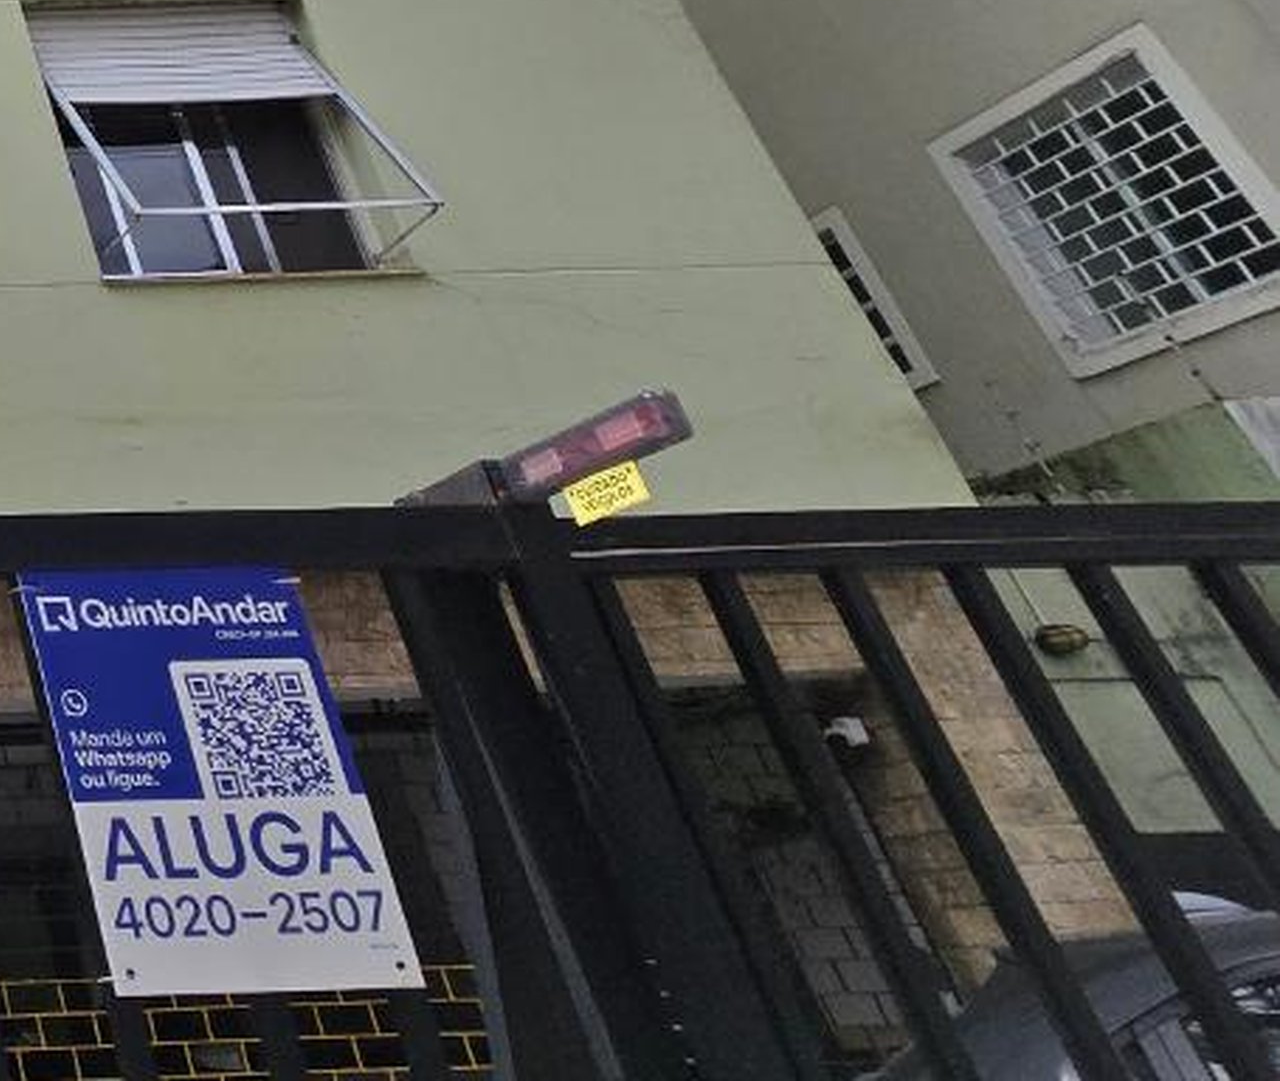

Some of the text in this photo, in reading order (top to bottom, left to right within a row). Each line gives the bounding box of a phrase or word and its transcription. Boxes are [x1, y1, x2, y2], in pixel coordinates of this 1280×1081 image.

[79, 595, 288, 629] QuintoAndar
[69, 729, 167, 748] Mande um
[74, 750, 172, 770] Whatsapp
[80, 773, 105, 789] ou
[104, 810, 374, 881] ALUGA
[114, 890, 384, 939] 4020-2507
